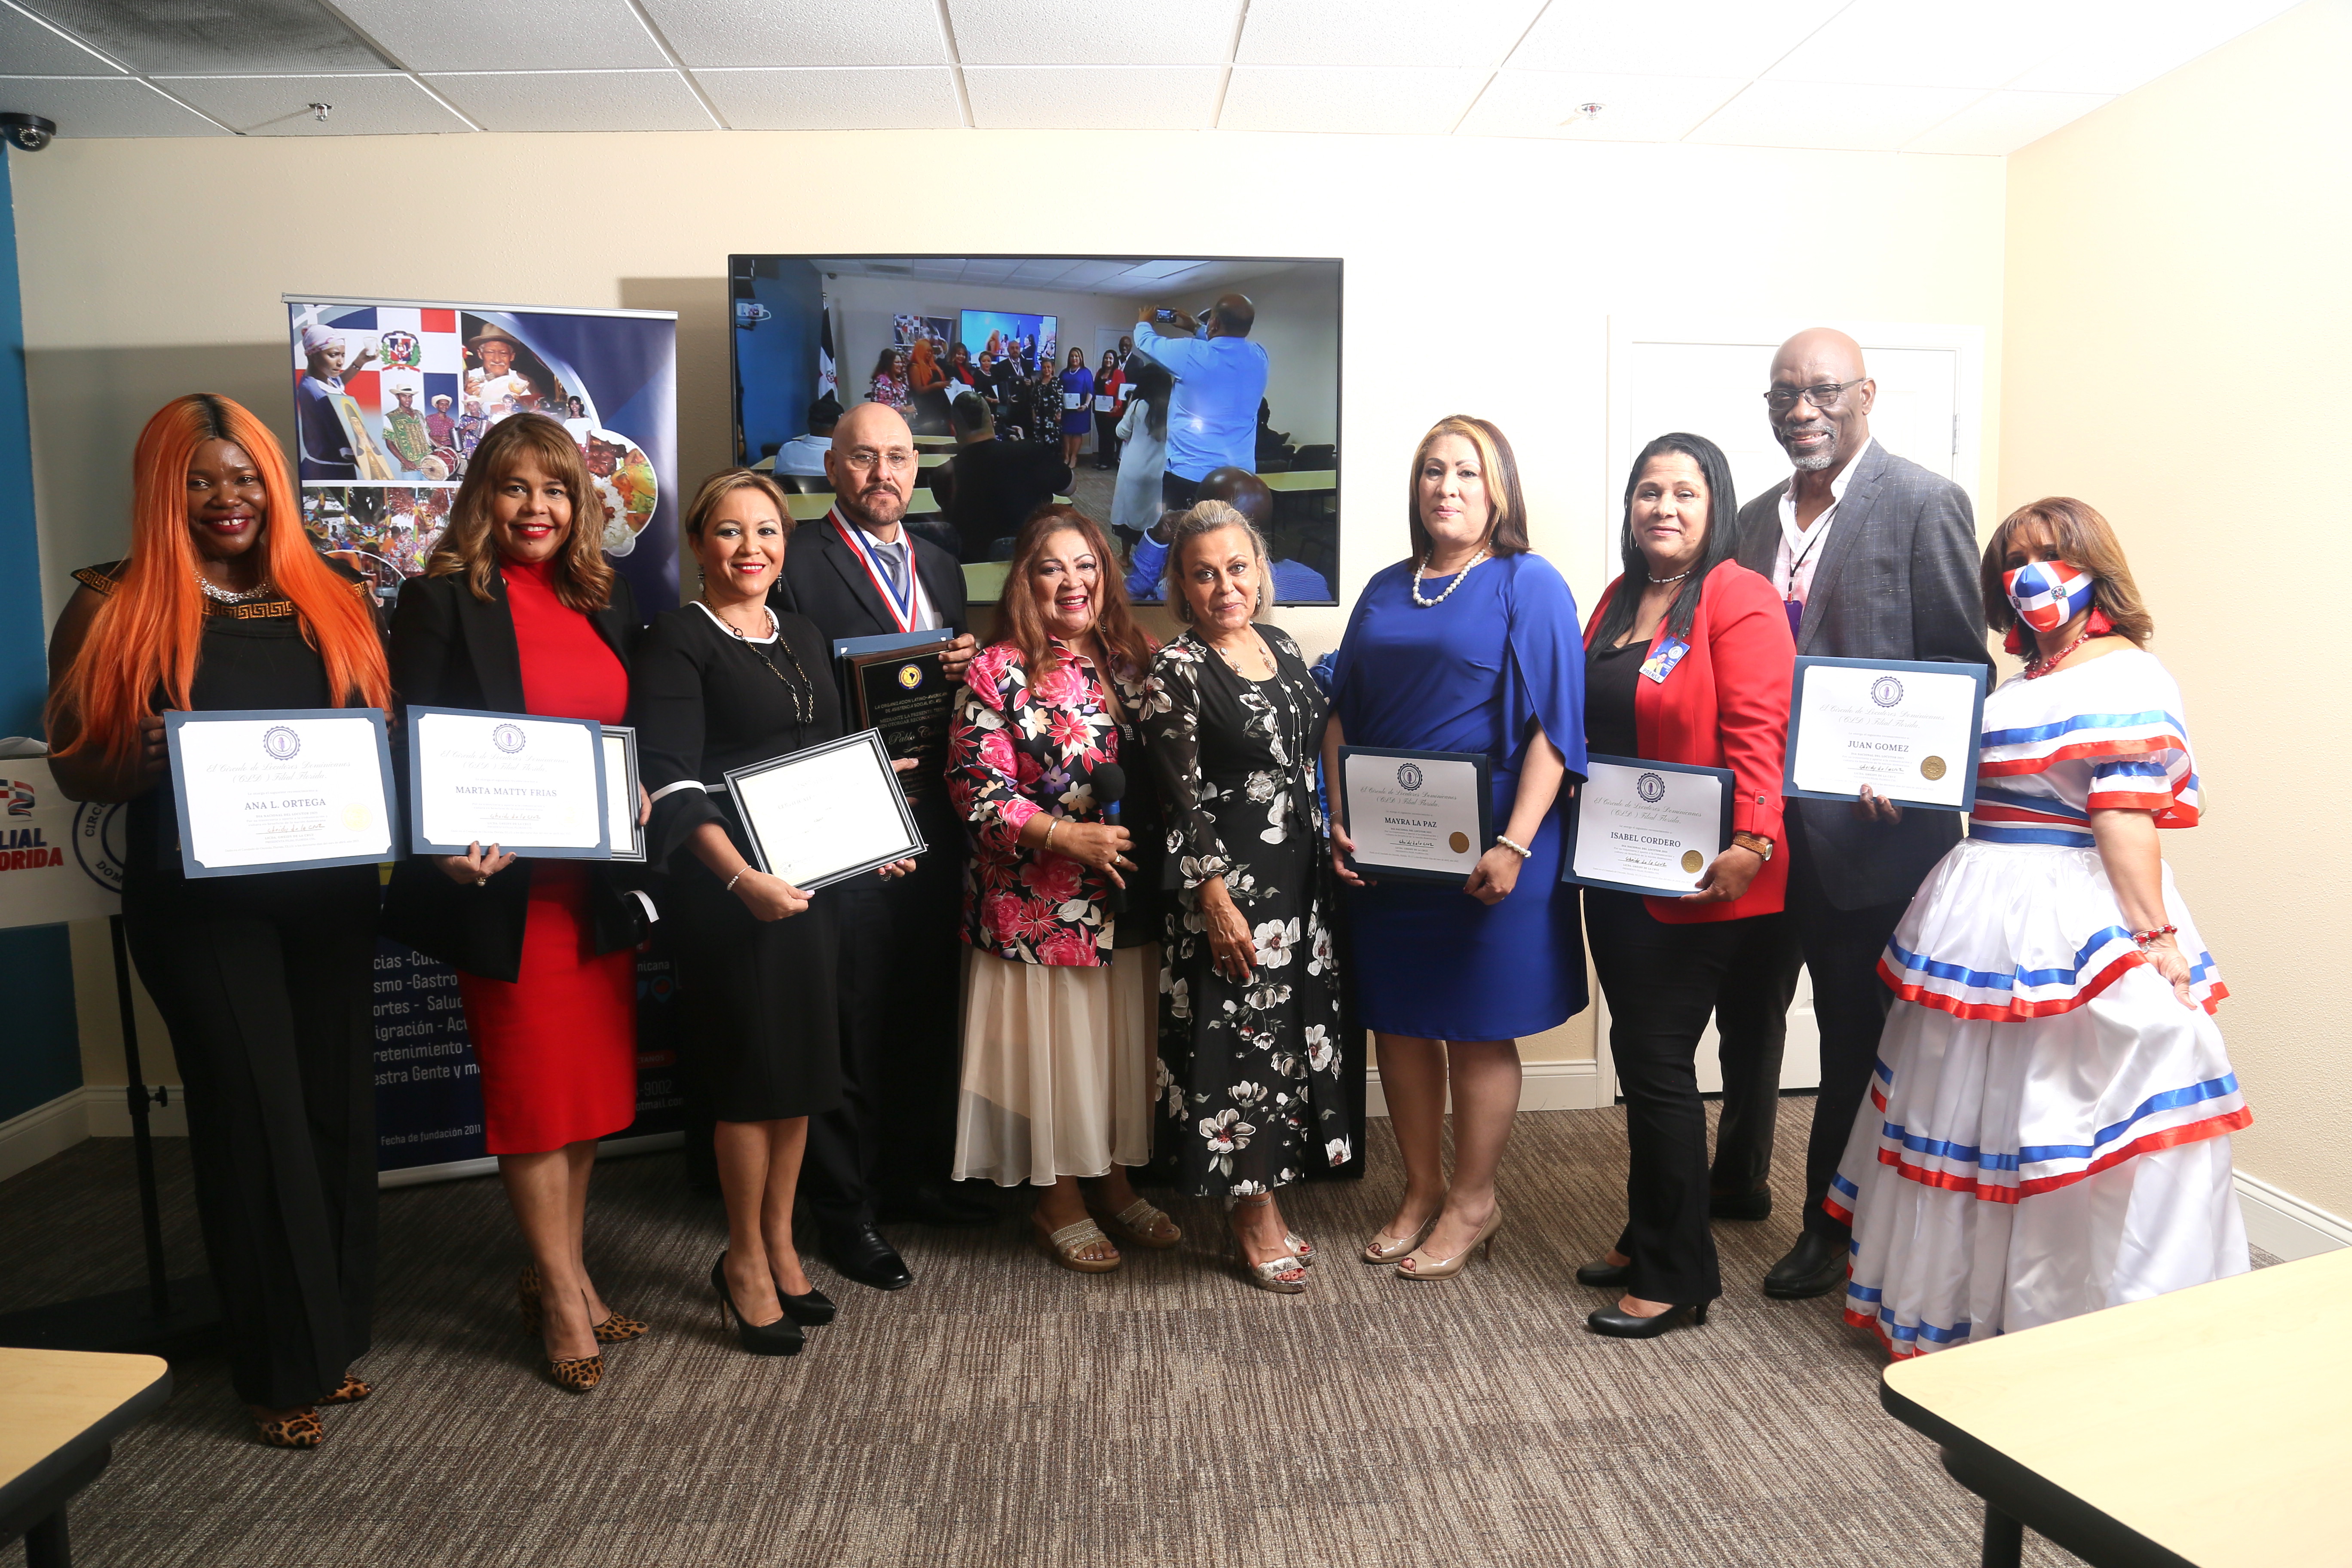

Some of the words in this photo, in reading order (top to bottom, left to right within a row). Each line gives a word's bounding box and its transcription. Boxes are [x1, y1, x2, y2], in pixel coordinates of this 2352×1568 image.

[1642, 668, 1660, 681] PRENSA
[880, 715, 903, 723] MEDIANTE
[888, 731, 915, 744] Pablo
[1875, 743, 1908, 752] GOMEZ
[250, 762, 259, 770] de
[272, 772, 297, 781] Filial
[282, 799, 325, 807] ORTEGA
[1611, 832, 1638, 841] ISABEL
[1641, 836, 1680, 847] CORDERO
[0, 847, 64, 872] ORIDA
[374, 980, 402, 993] smo
[373, 1002, 409, 1016] ortes
[375, 1020, 433, 1041] igración
[374, 1041, 462, 1062] retenimiento
[413, 1066, 450, 1081] Gente
[454, 1066, 461, 1078] y
[381, 1135, 405, 1145] Fecha
[408, 1133, 419, 1142] de
[420, 1127, 462, 1142] fundación
[465, 1124, 481, 1135] 2011
